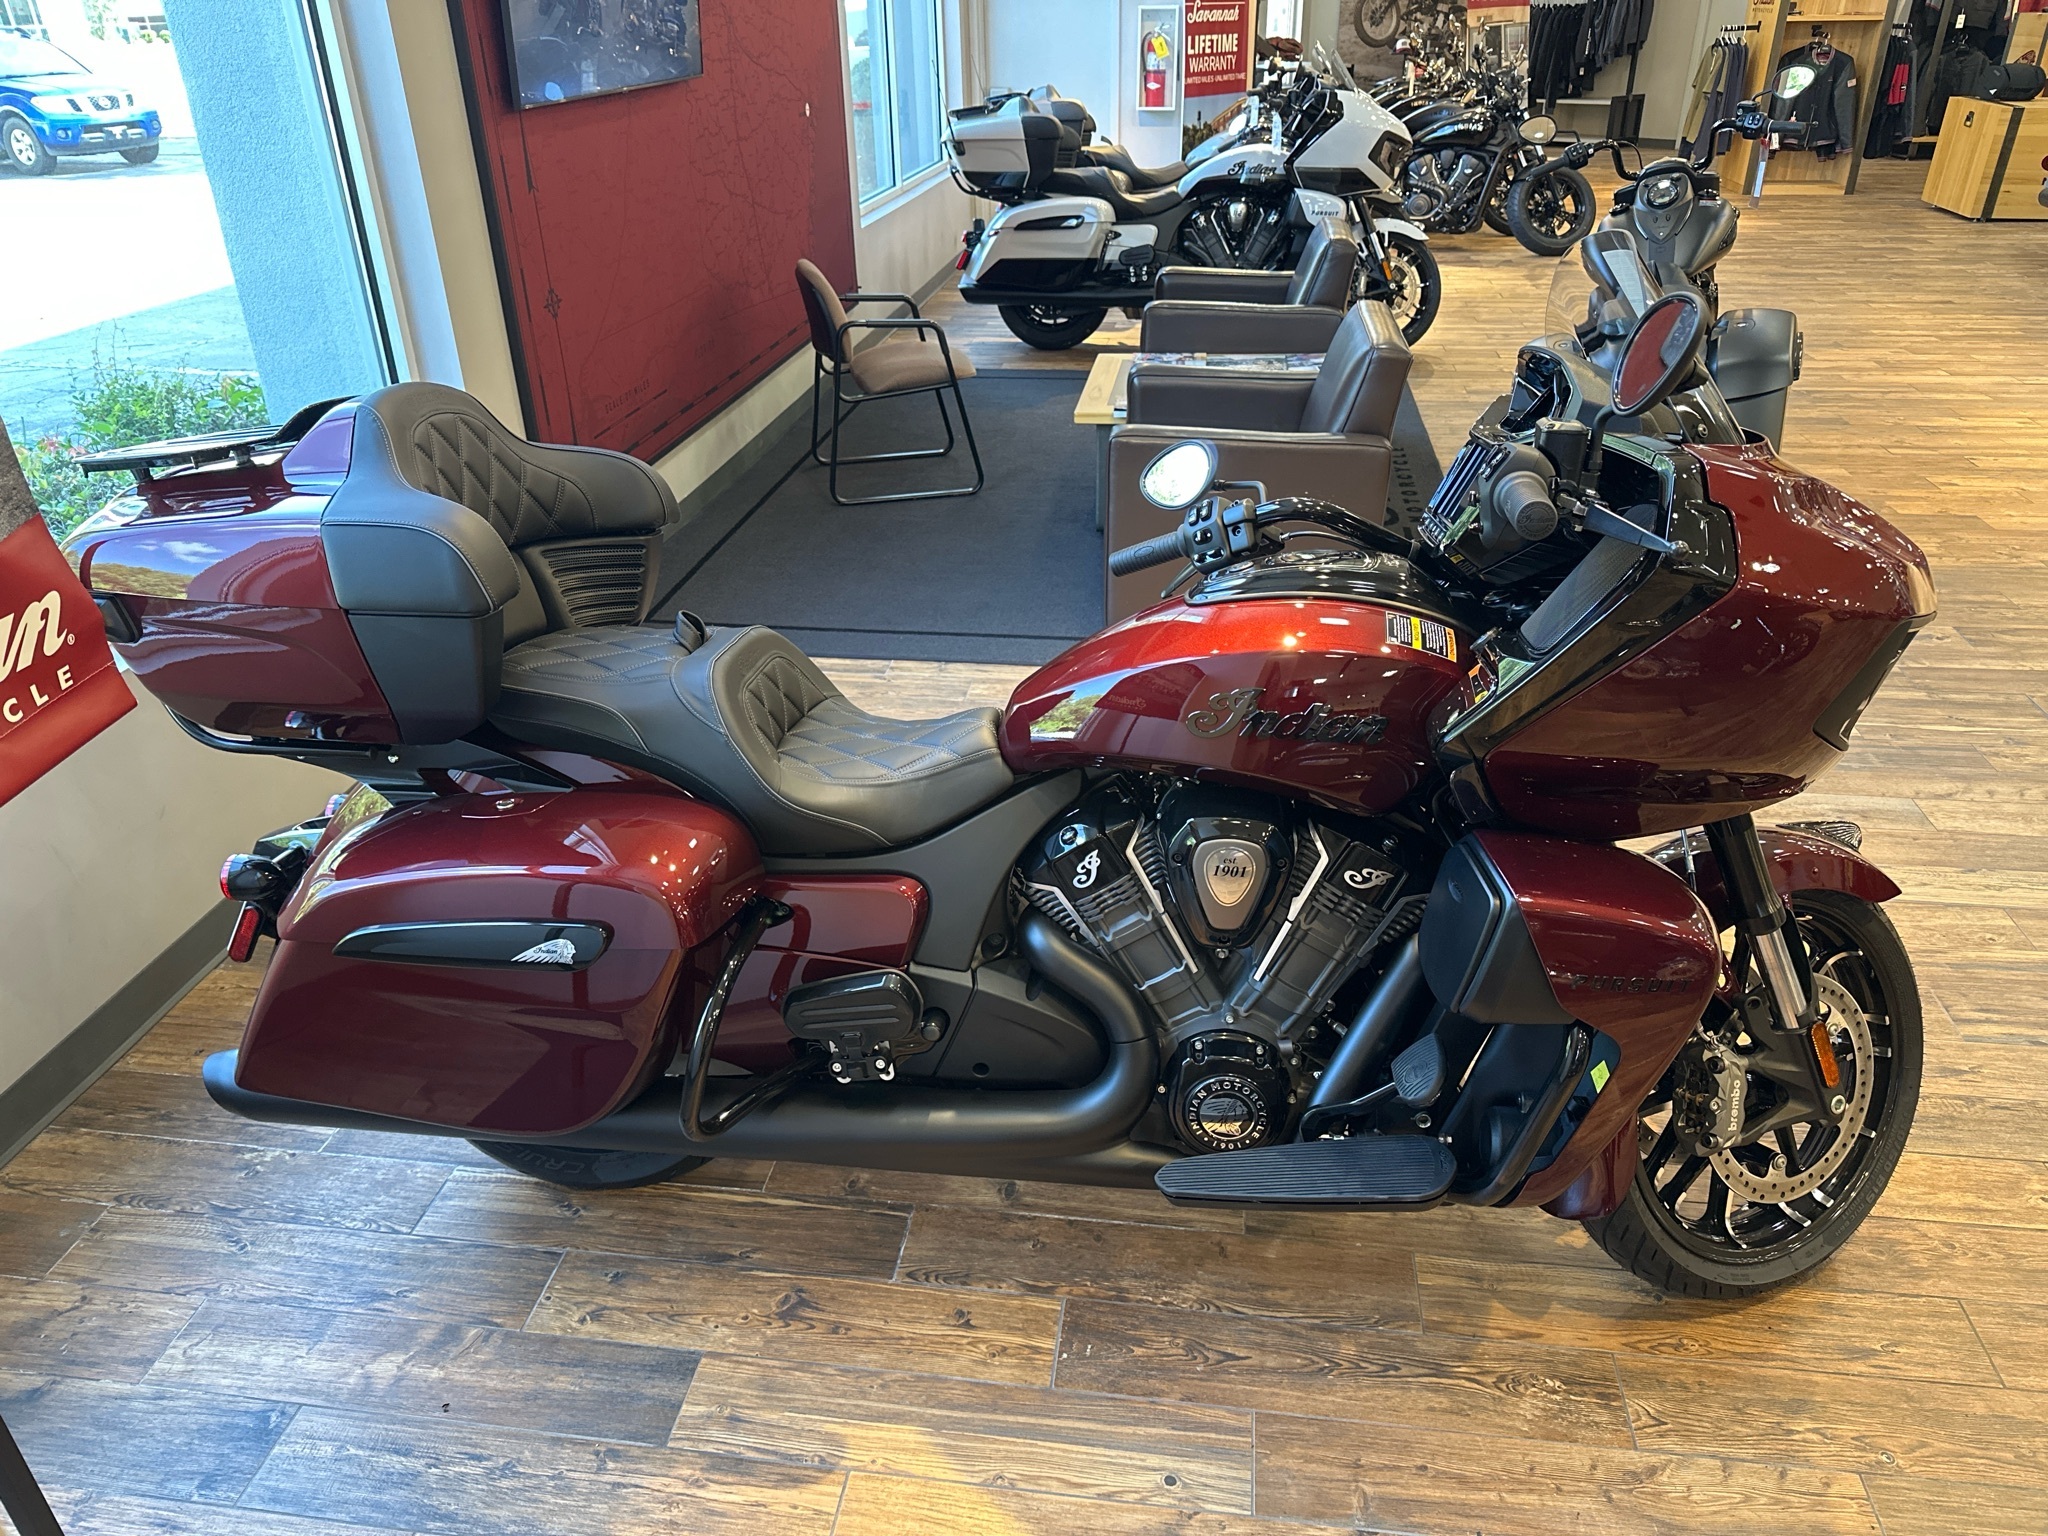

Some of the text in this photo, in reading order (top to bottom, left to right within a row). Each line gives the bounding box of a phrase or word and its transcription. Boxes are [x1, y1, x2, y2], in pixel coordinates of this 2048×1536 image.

[1187, 0, 1239, 24] Savannah
[1187, 33, 1238, 55] LIFETIME
[1189, 55, 1237, 73] WARRANTY
[1228, 161, 1277, 175] Idian
[1186, 687, 1389, 745] Indian
[1213, 865, 1247, 877] 1901
[1569, 974, 1694, 993] PURSUIT
[1189, 1081, 1267, 1139] INDIAN MOTORCYCLE
[1728, 1080, 1741, 1131] brembo
[1212, 1141, 1242, 1149] 1901
